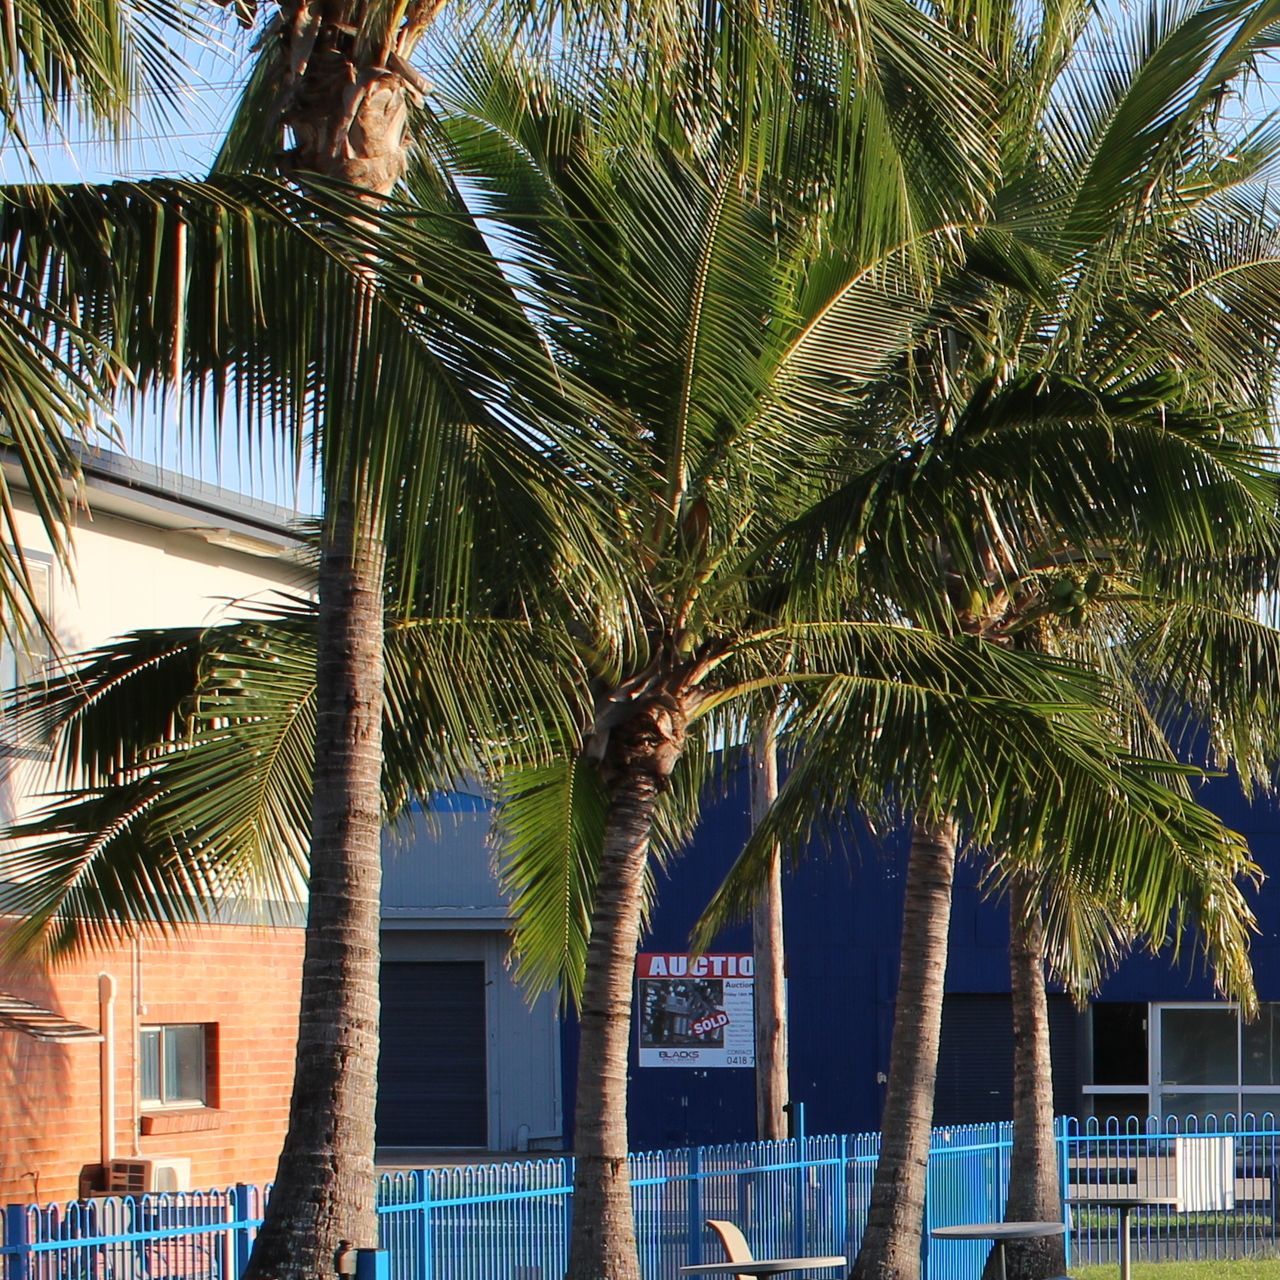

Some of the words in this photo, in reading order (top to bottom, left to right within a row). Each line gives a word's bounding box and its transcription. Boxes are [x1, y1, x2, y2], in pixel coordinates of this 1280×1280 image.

[649, 956, 754, 976] AUCTIO
[694, 1014, 727, 1034] SOLD
[727, 1056, 747, 1065] 0418
